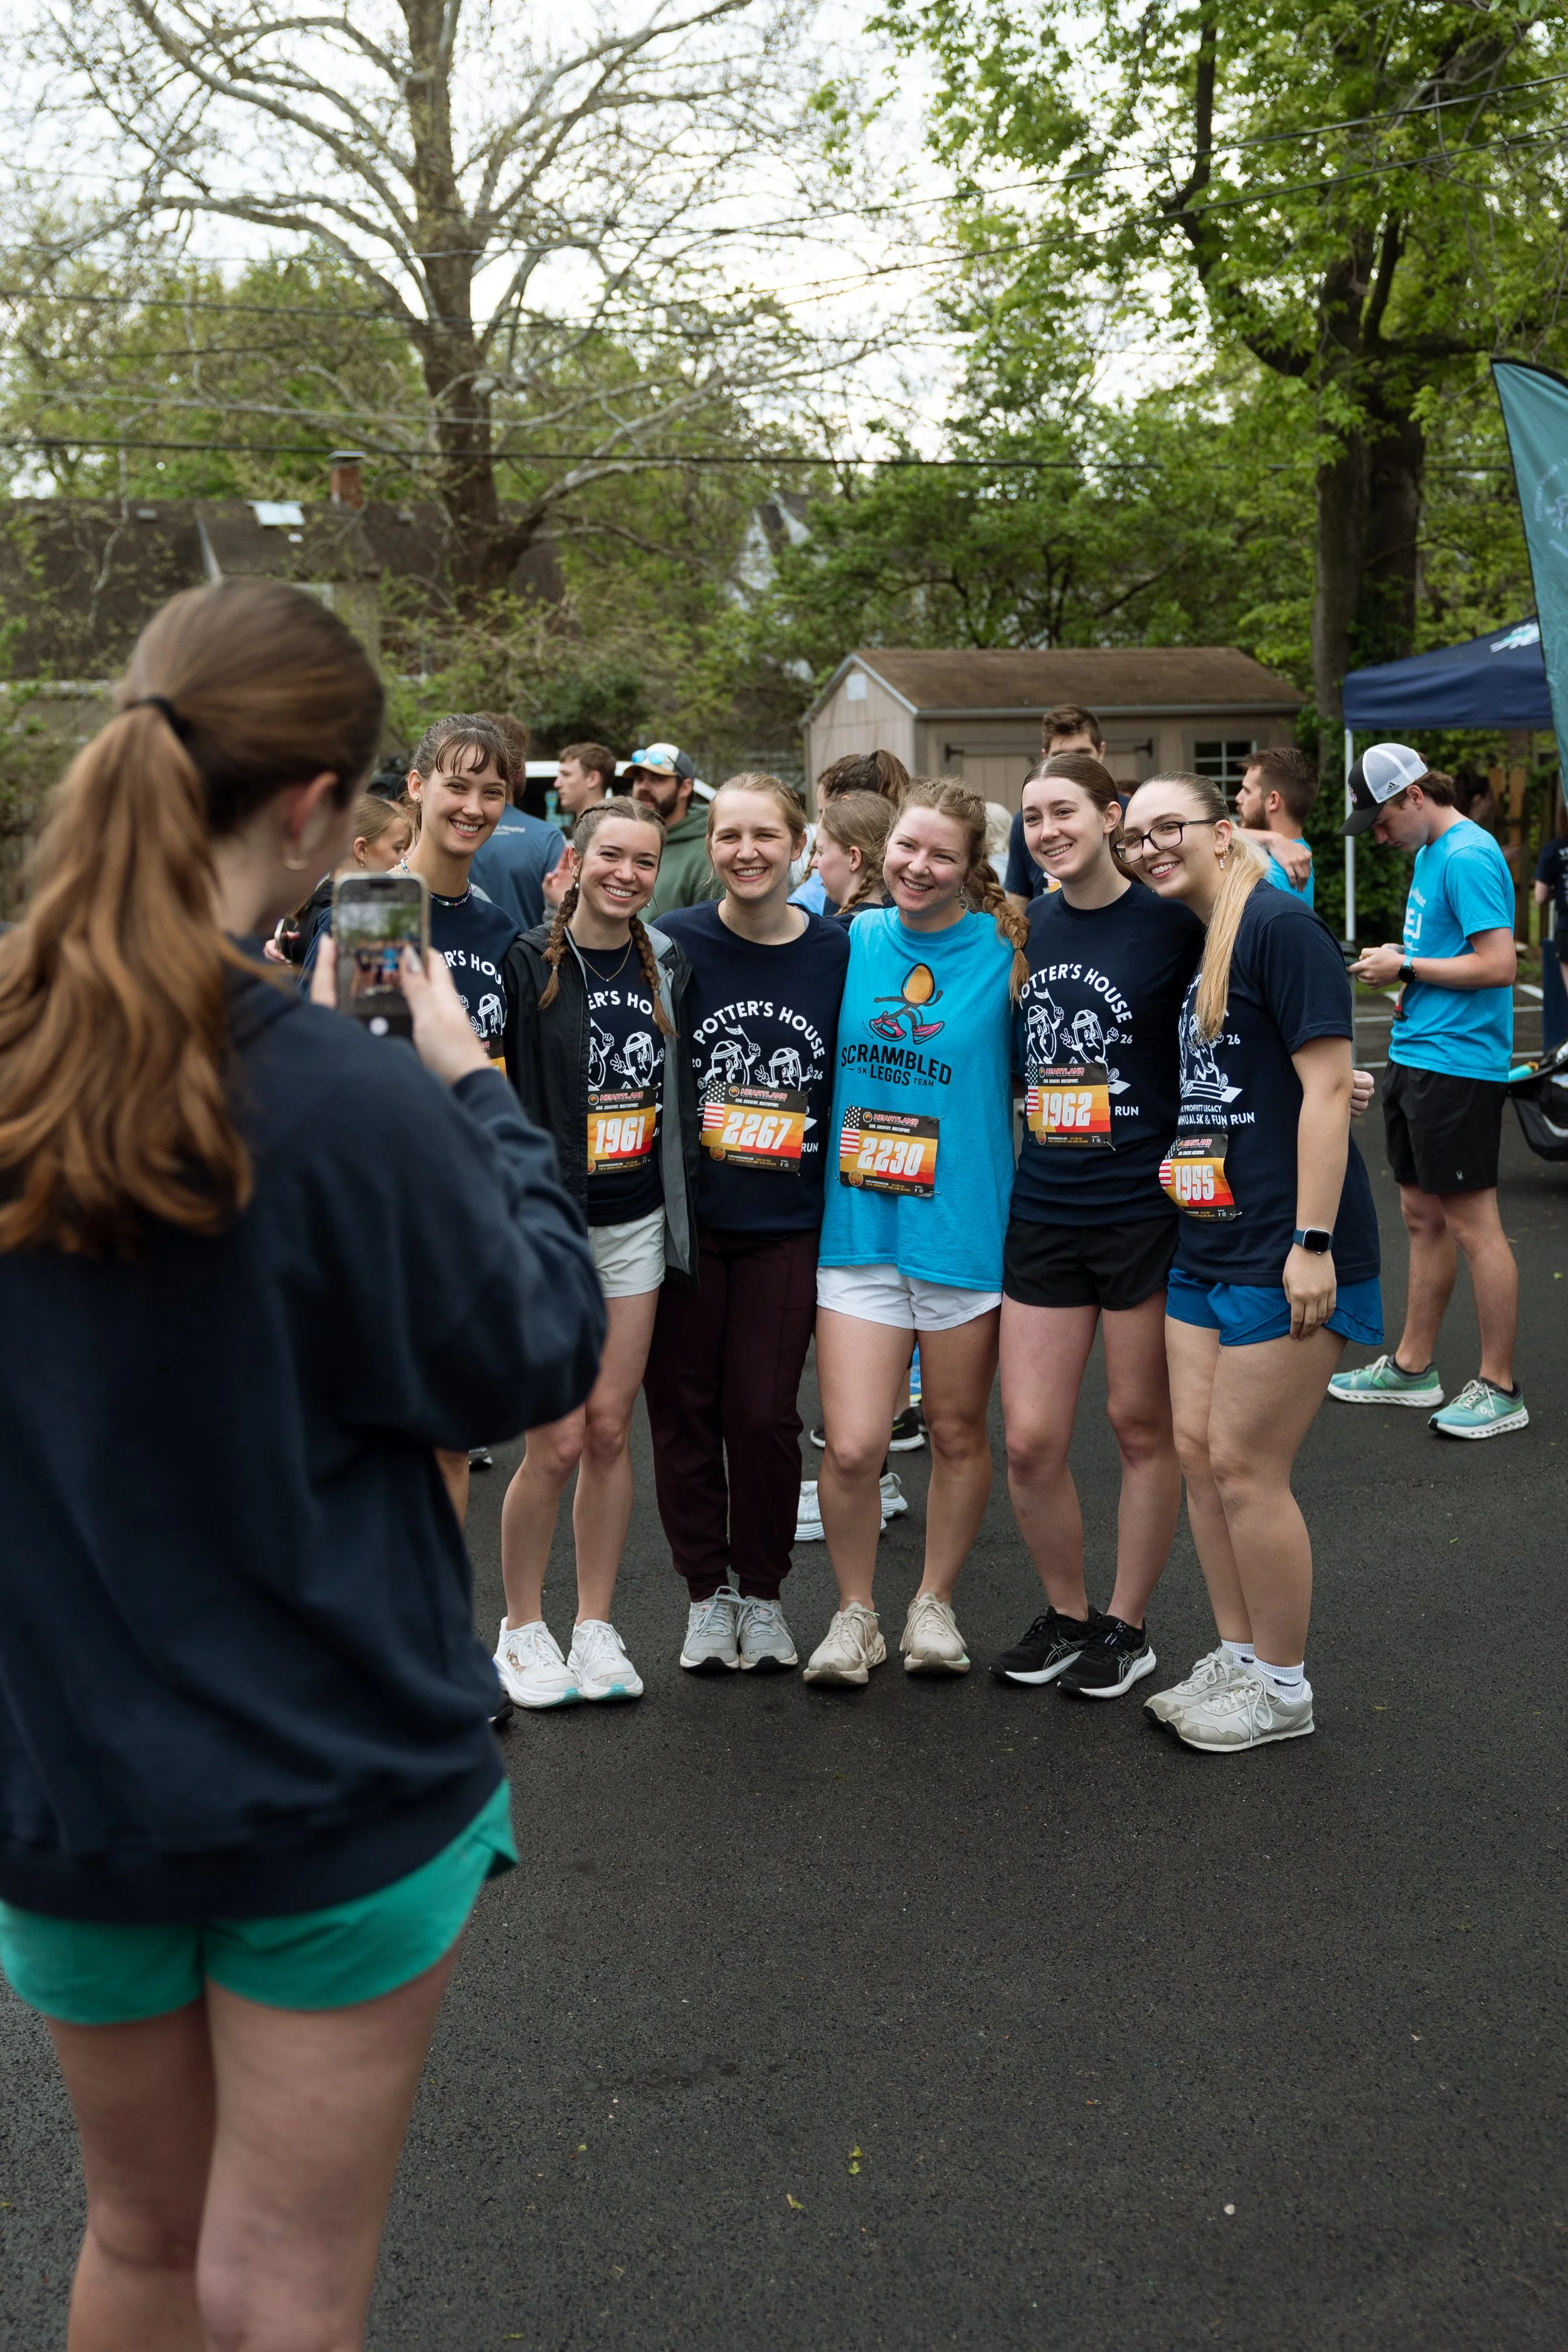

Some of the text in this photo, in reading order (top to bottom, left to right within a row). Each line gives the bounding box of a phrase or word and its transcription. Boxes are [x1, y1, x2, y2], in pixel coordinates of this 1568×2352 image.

[1020, 963, 1082, 1010] OTTER'S
[1084, 968, 1133, 1024] HOUSE
[693, 1000, 825, 1059] POTTER'S HOUSE
[1120, 1034, 1133, 1044] 26
[1226, 1034, 1241, 1045] 26
[842, 1044, 951, 1085] SCRAMBLED
[813, 1070, 824, 1080] 26
[870, 1064, 911, 1086] LEGGS
[913, 1078, 934, 1087] TEAM
[600, 1091, 644, 1101] HEARTLAND
[740, 1088, 788, 1099] HEARTLAND
[1042, 1092, 1093, 1126] 1962
[1115, 1106, 1139, 1116] RUN
[1184, 1104, 1203, 1113] PROFFITT
[1204, 1104, 1222, 1113] LEGACY
[873, 1114, 919, 1125] HEARTLAND
[1197, 1114, 1204, 1124] 5K
[1205, 1115, 1211, 1125] &
[1211, 1115, 1227, 1126] FUN
[1230, 1112, 1255, 1125] RUN
[595, 1116, 645, 1154] 1961
[721, 1112, 793, 1150] 2267
[802, 1143, 818, 1153] RUN
[857, 1137, 924, 1176] 2230
[1174, 1165, 1214, 1200] 1955
